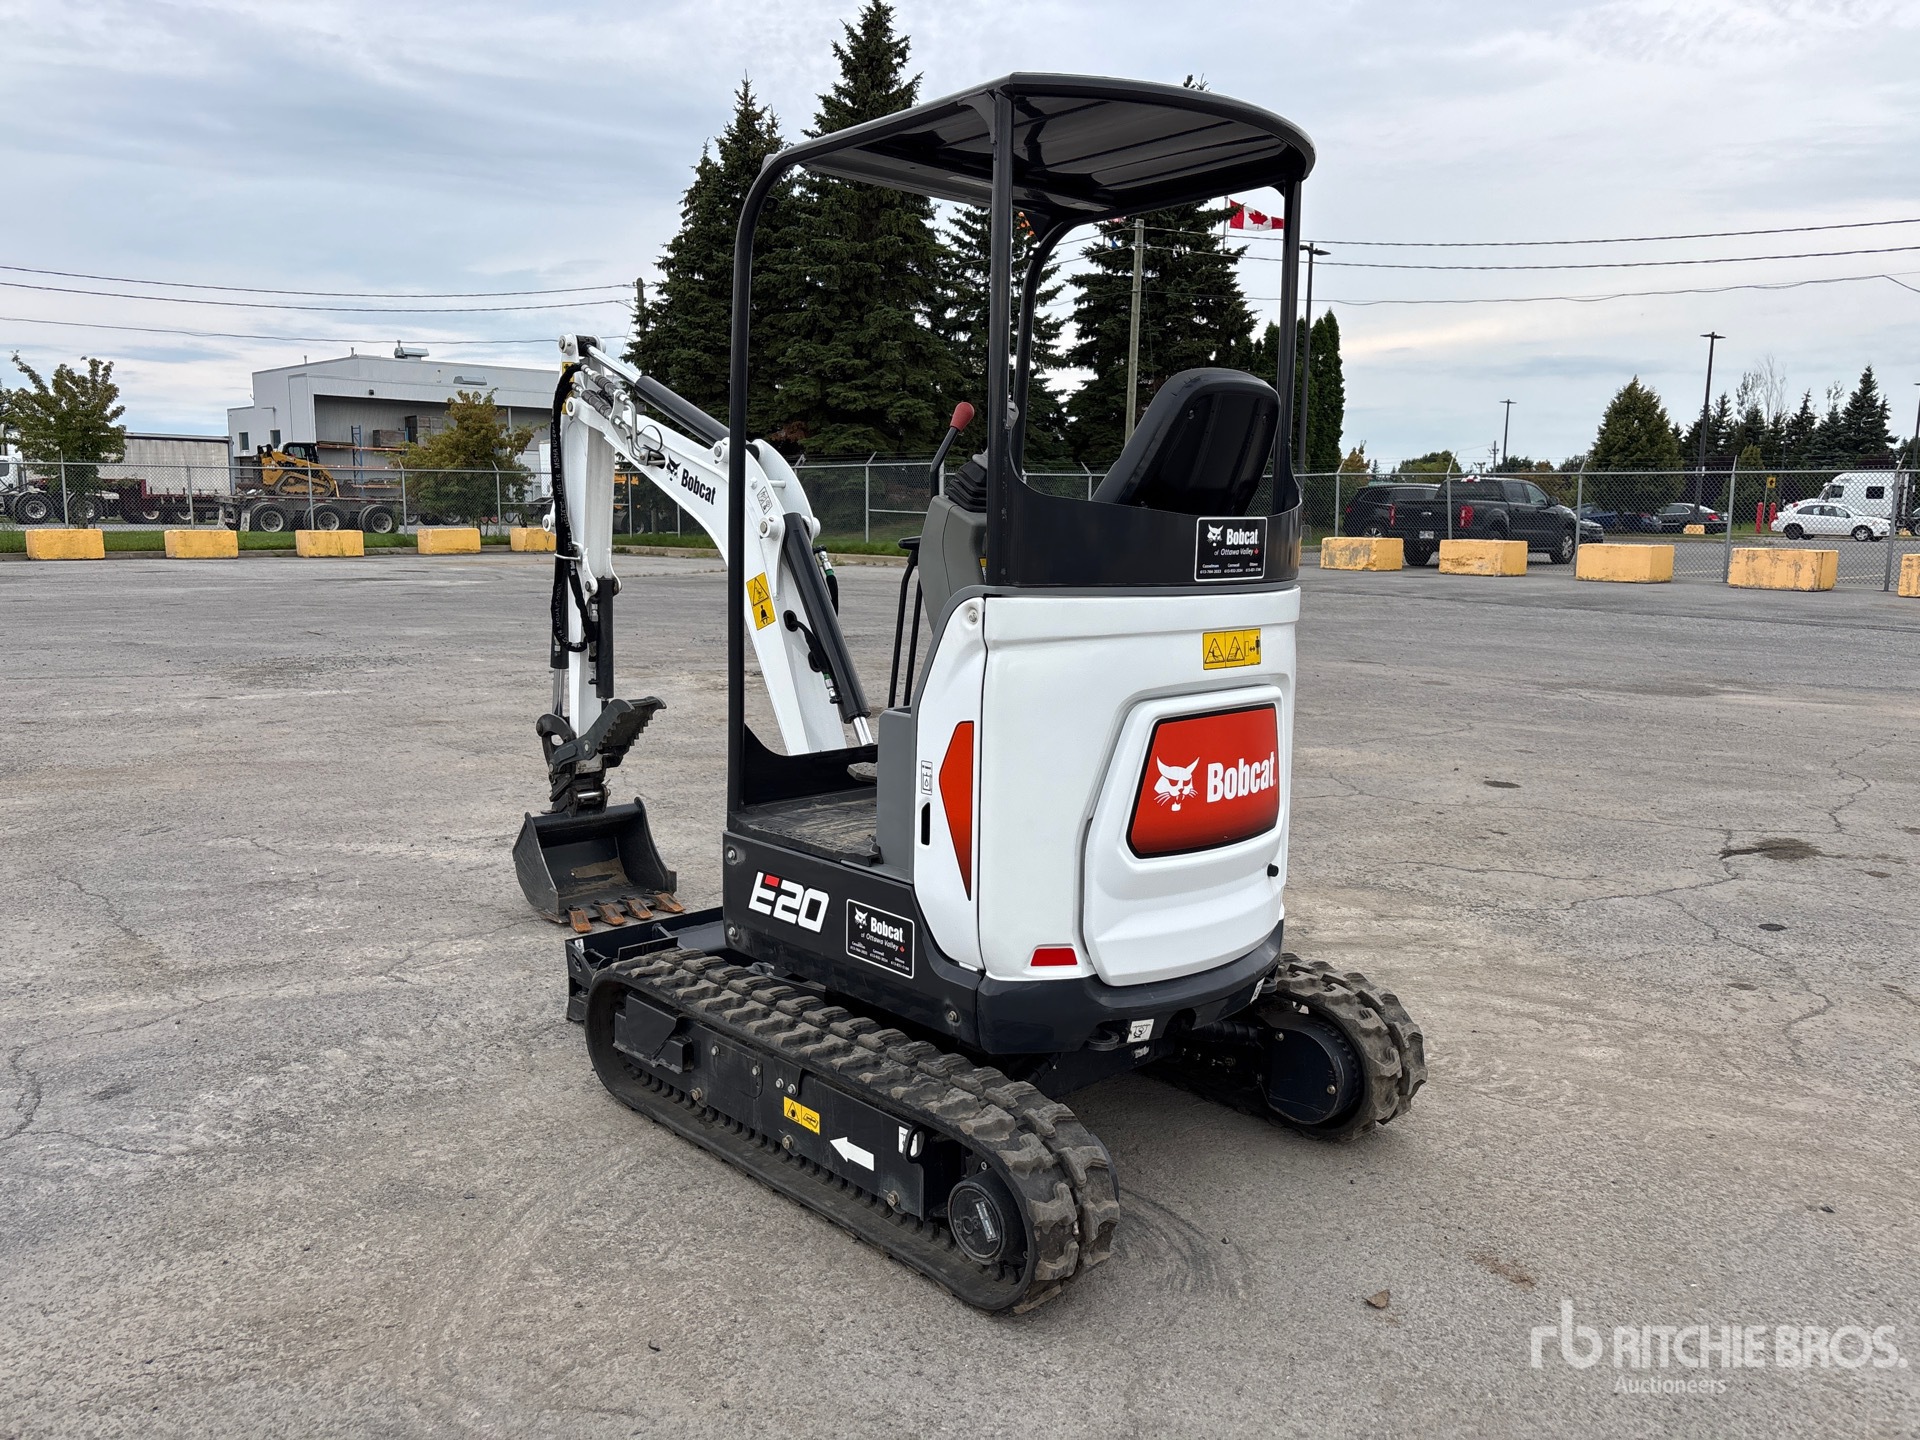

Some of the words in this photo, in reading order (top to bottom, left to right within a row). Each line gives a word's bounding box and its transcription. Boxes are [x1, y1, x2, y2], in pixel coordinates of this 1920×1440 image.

[681, 468, 716, 505] Bobcat
[1226, 528, 1258, 546] Bobcat
[1240, 548, 1254, 556] Valley
[1206, 751, 1275, 803] Bobcat
[748, 872, 830, 933] E20
[870, 917, 903, 942] Bobcat
[866, 933, 884, 945] Ottawa
[884, 939, 899, 952] Valley
